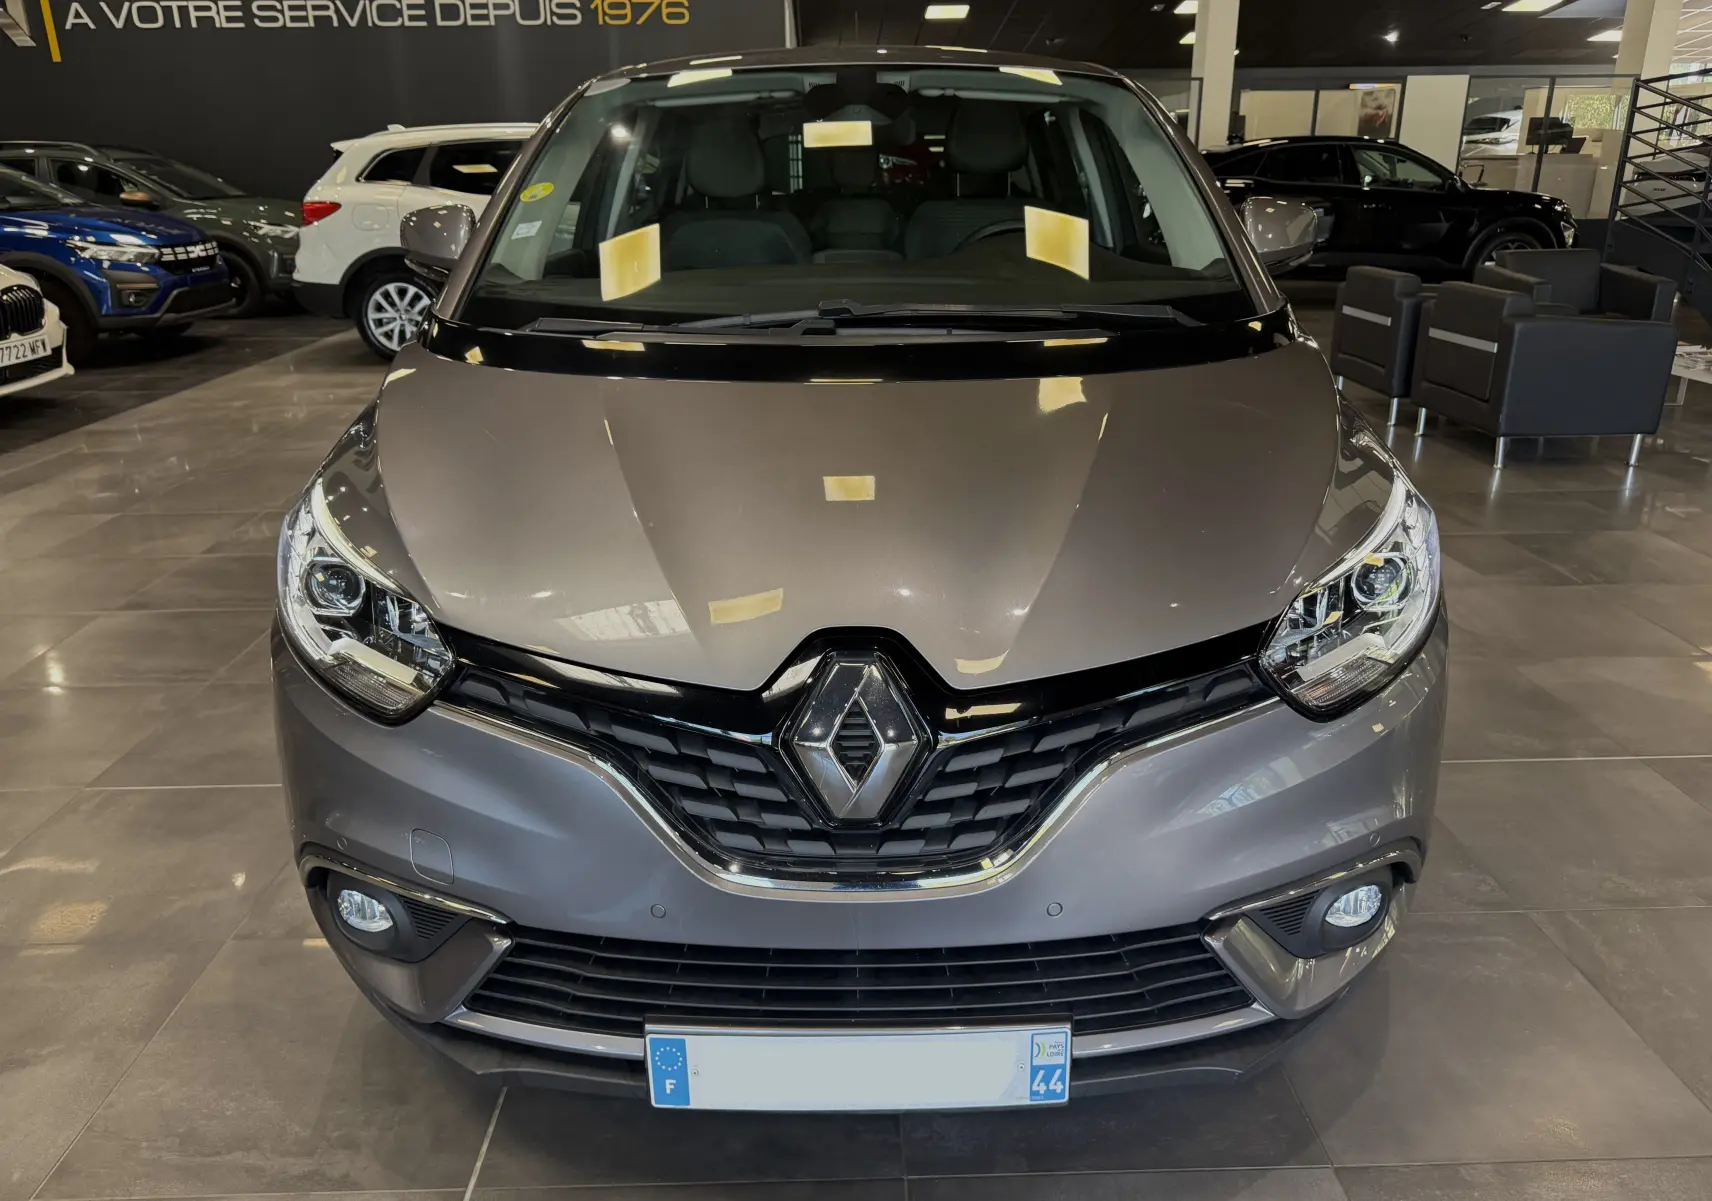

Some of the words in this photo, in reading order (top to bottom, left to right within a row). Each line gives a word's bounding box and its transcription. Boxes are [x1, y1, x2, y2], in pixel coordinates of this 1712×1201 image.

[99, 1, 245, 29] VOTRE
[251, 0, 428, 28] SERVICE
[435, 0, 582, 27] DEPUIS
[590, 0, 690, 26] 1976
[0, 343, 28, 363] 7722
[665, 1079, 677, 1095] F
[1032, 1068, 1064, 1094] 44
